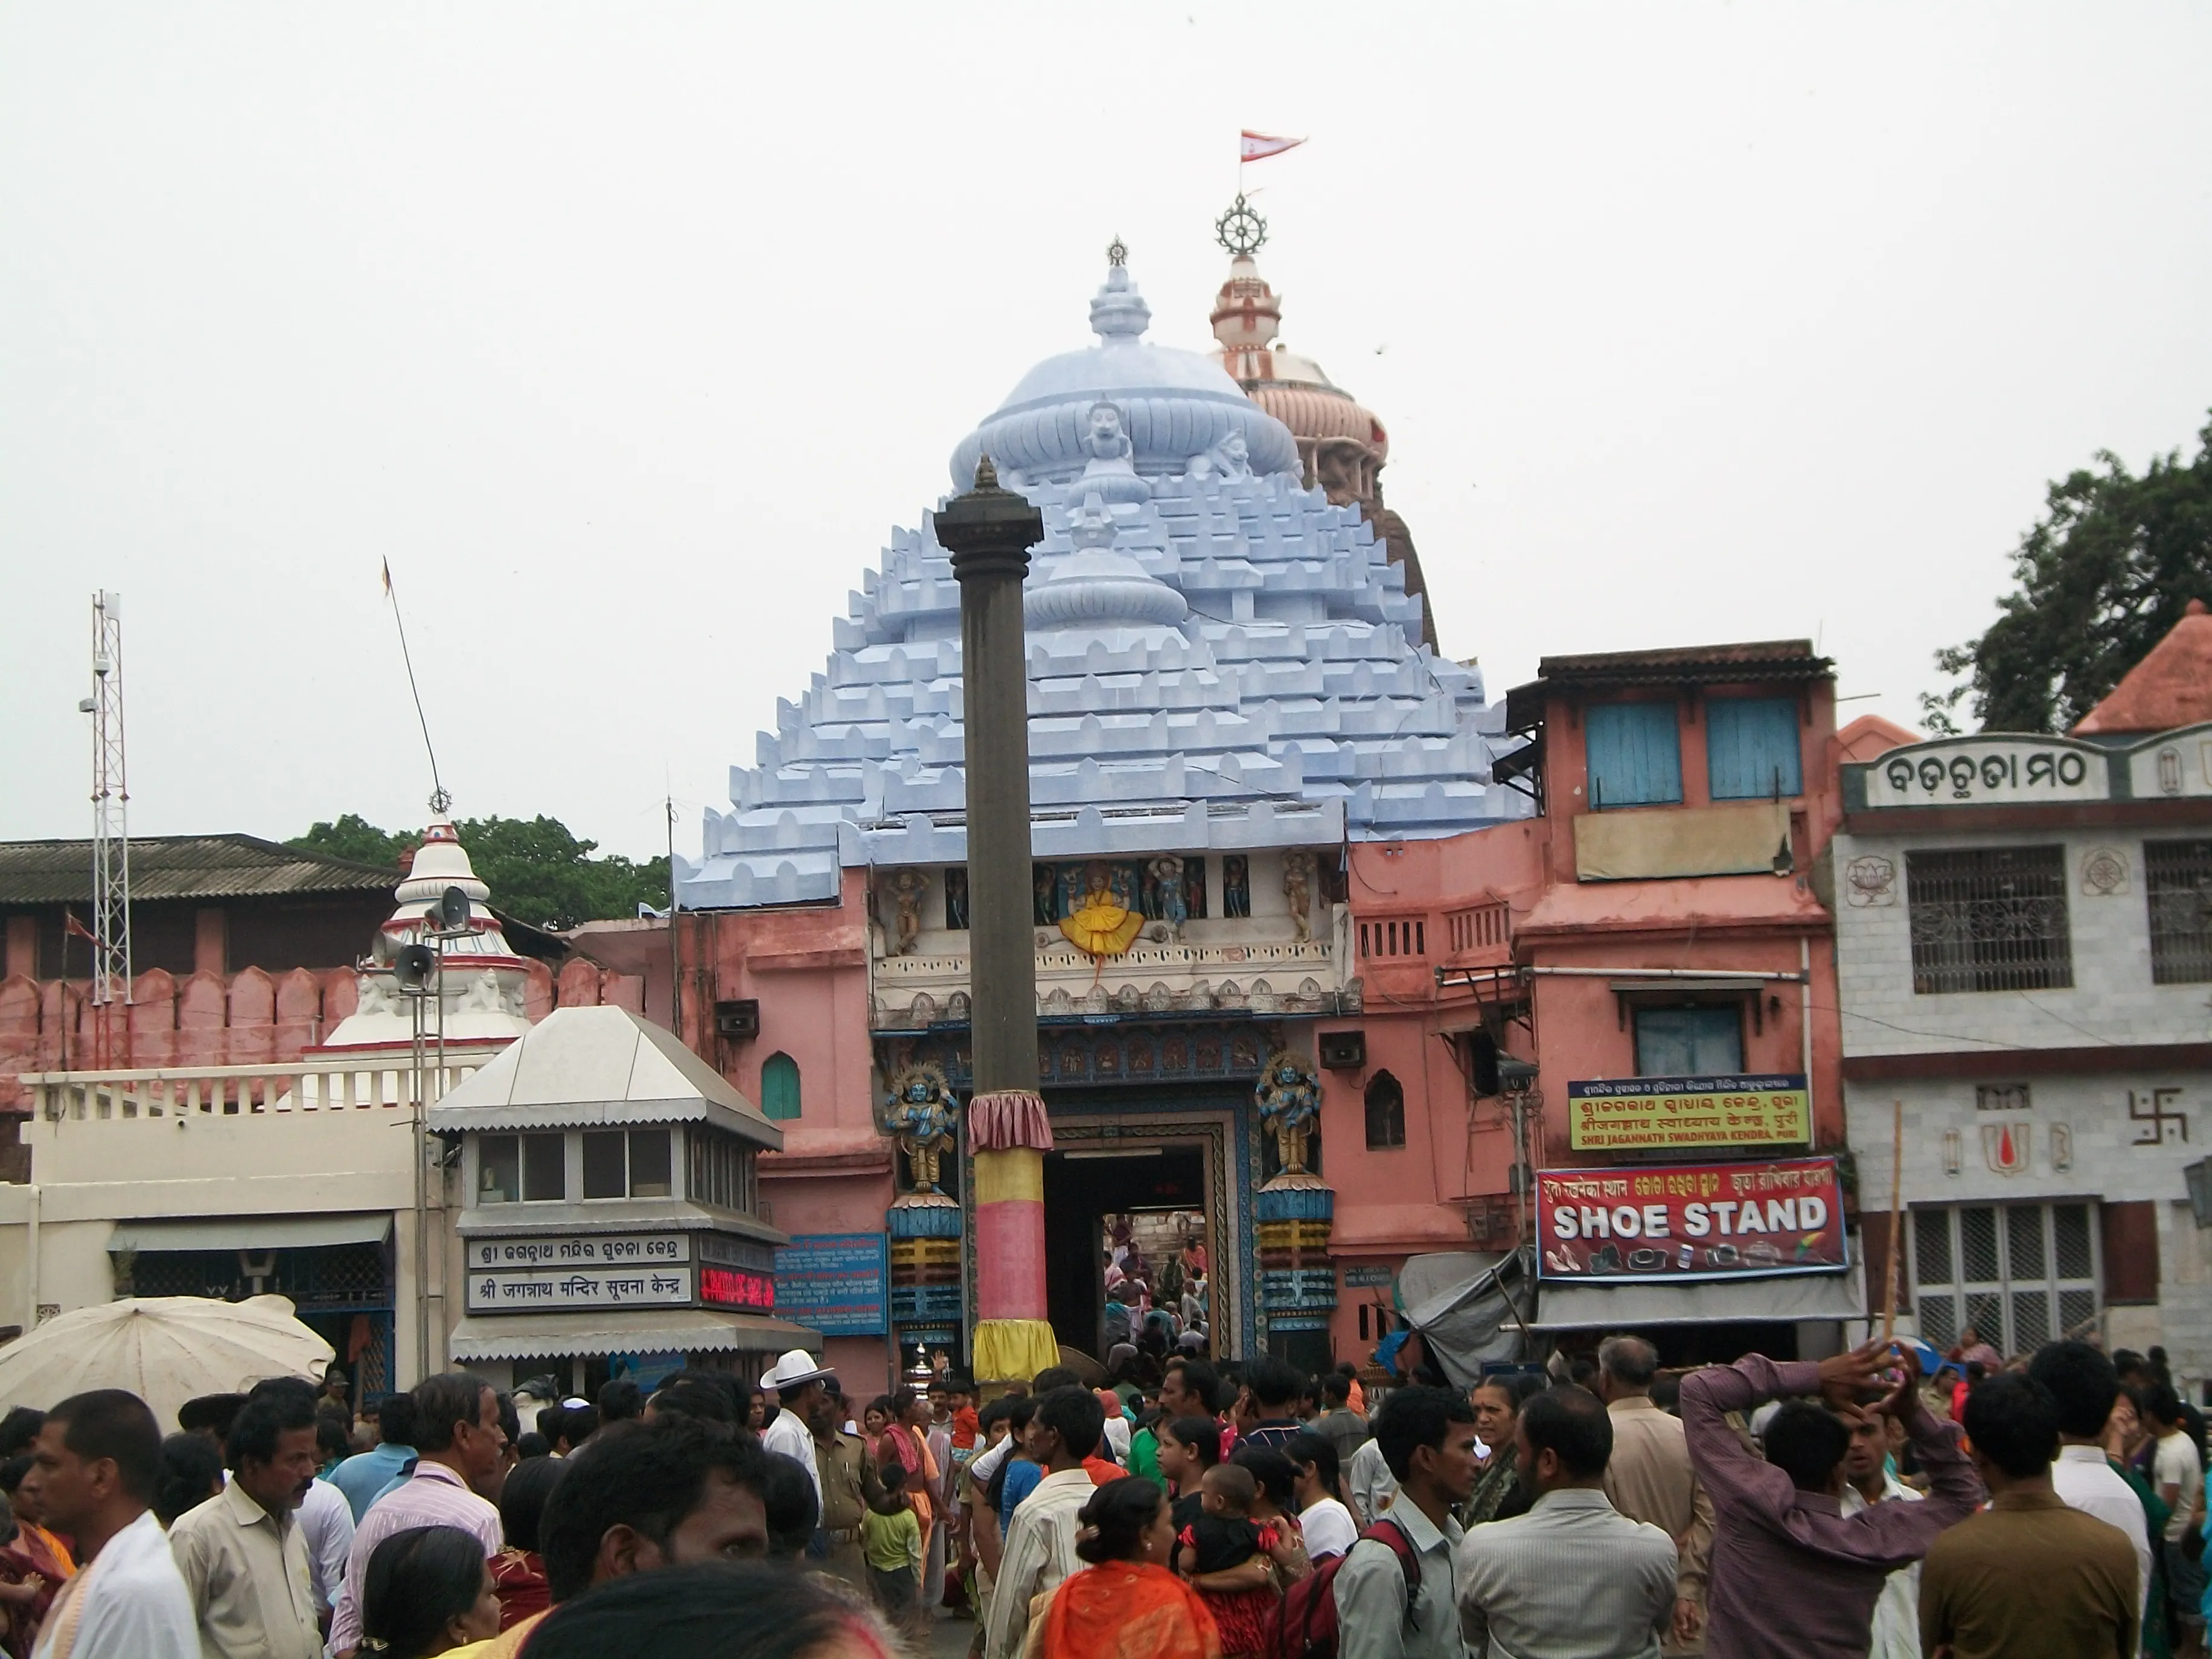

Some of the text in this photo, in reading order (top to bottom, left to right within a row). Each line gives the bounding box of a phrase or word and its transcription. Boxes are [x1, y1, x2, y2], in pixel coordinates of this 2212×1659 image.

[2027, 750, 2088, 788] ମଠ
[1773, 1111, 1798, 1128] पुरी
[1581, 1135, 1604, 1145] SHRI
[1607, 1133, 1665, 1146] JAGANNATH
[1669, 1131, 1728, 1142] SWADHYAYA
[1777, 1130, 1798, 1139] PURI
[1602, 1179, 1628, 1198] स्थान
[1553, 1196, 1828, 1239] SHOE STAND
[481, 1246, 498, 1264] ଶ୍ରୀ
[480, 1277, 497, 1300] श्री
[502, 1282, 554, 1299] जगन्नाथ
[560, 1274, 599, 1297] मन्दिर
[606, 1280, 645, 1301] सूचना
[651, 1273, 682, 1295] केन्द्र
